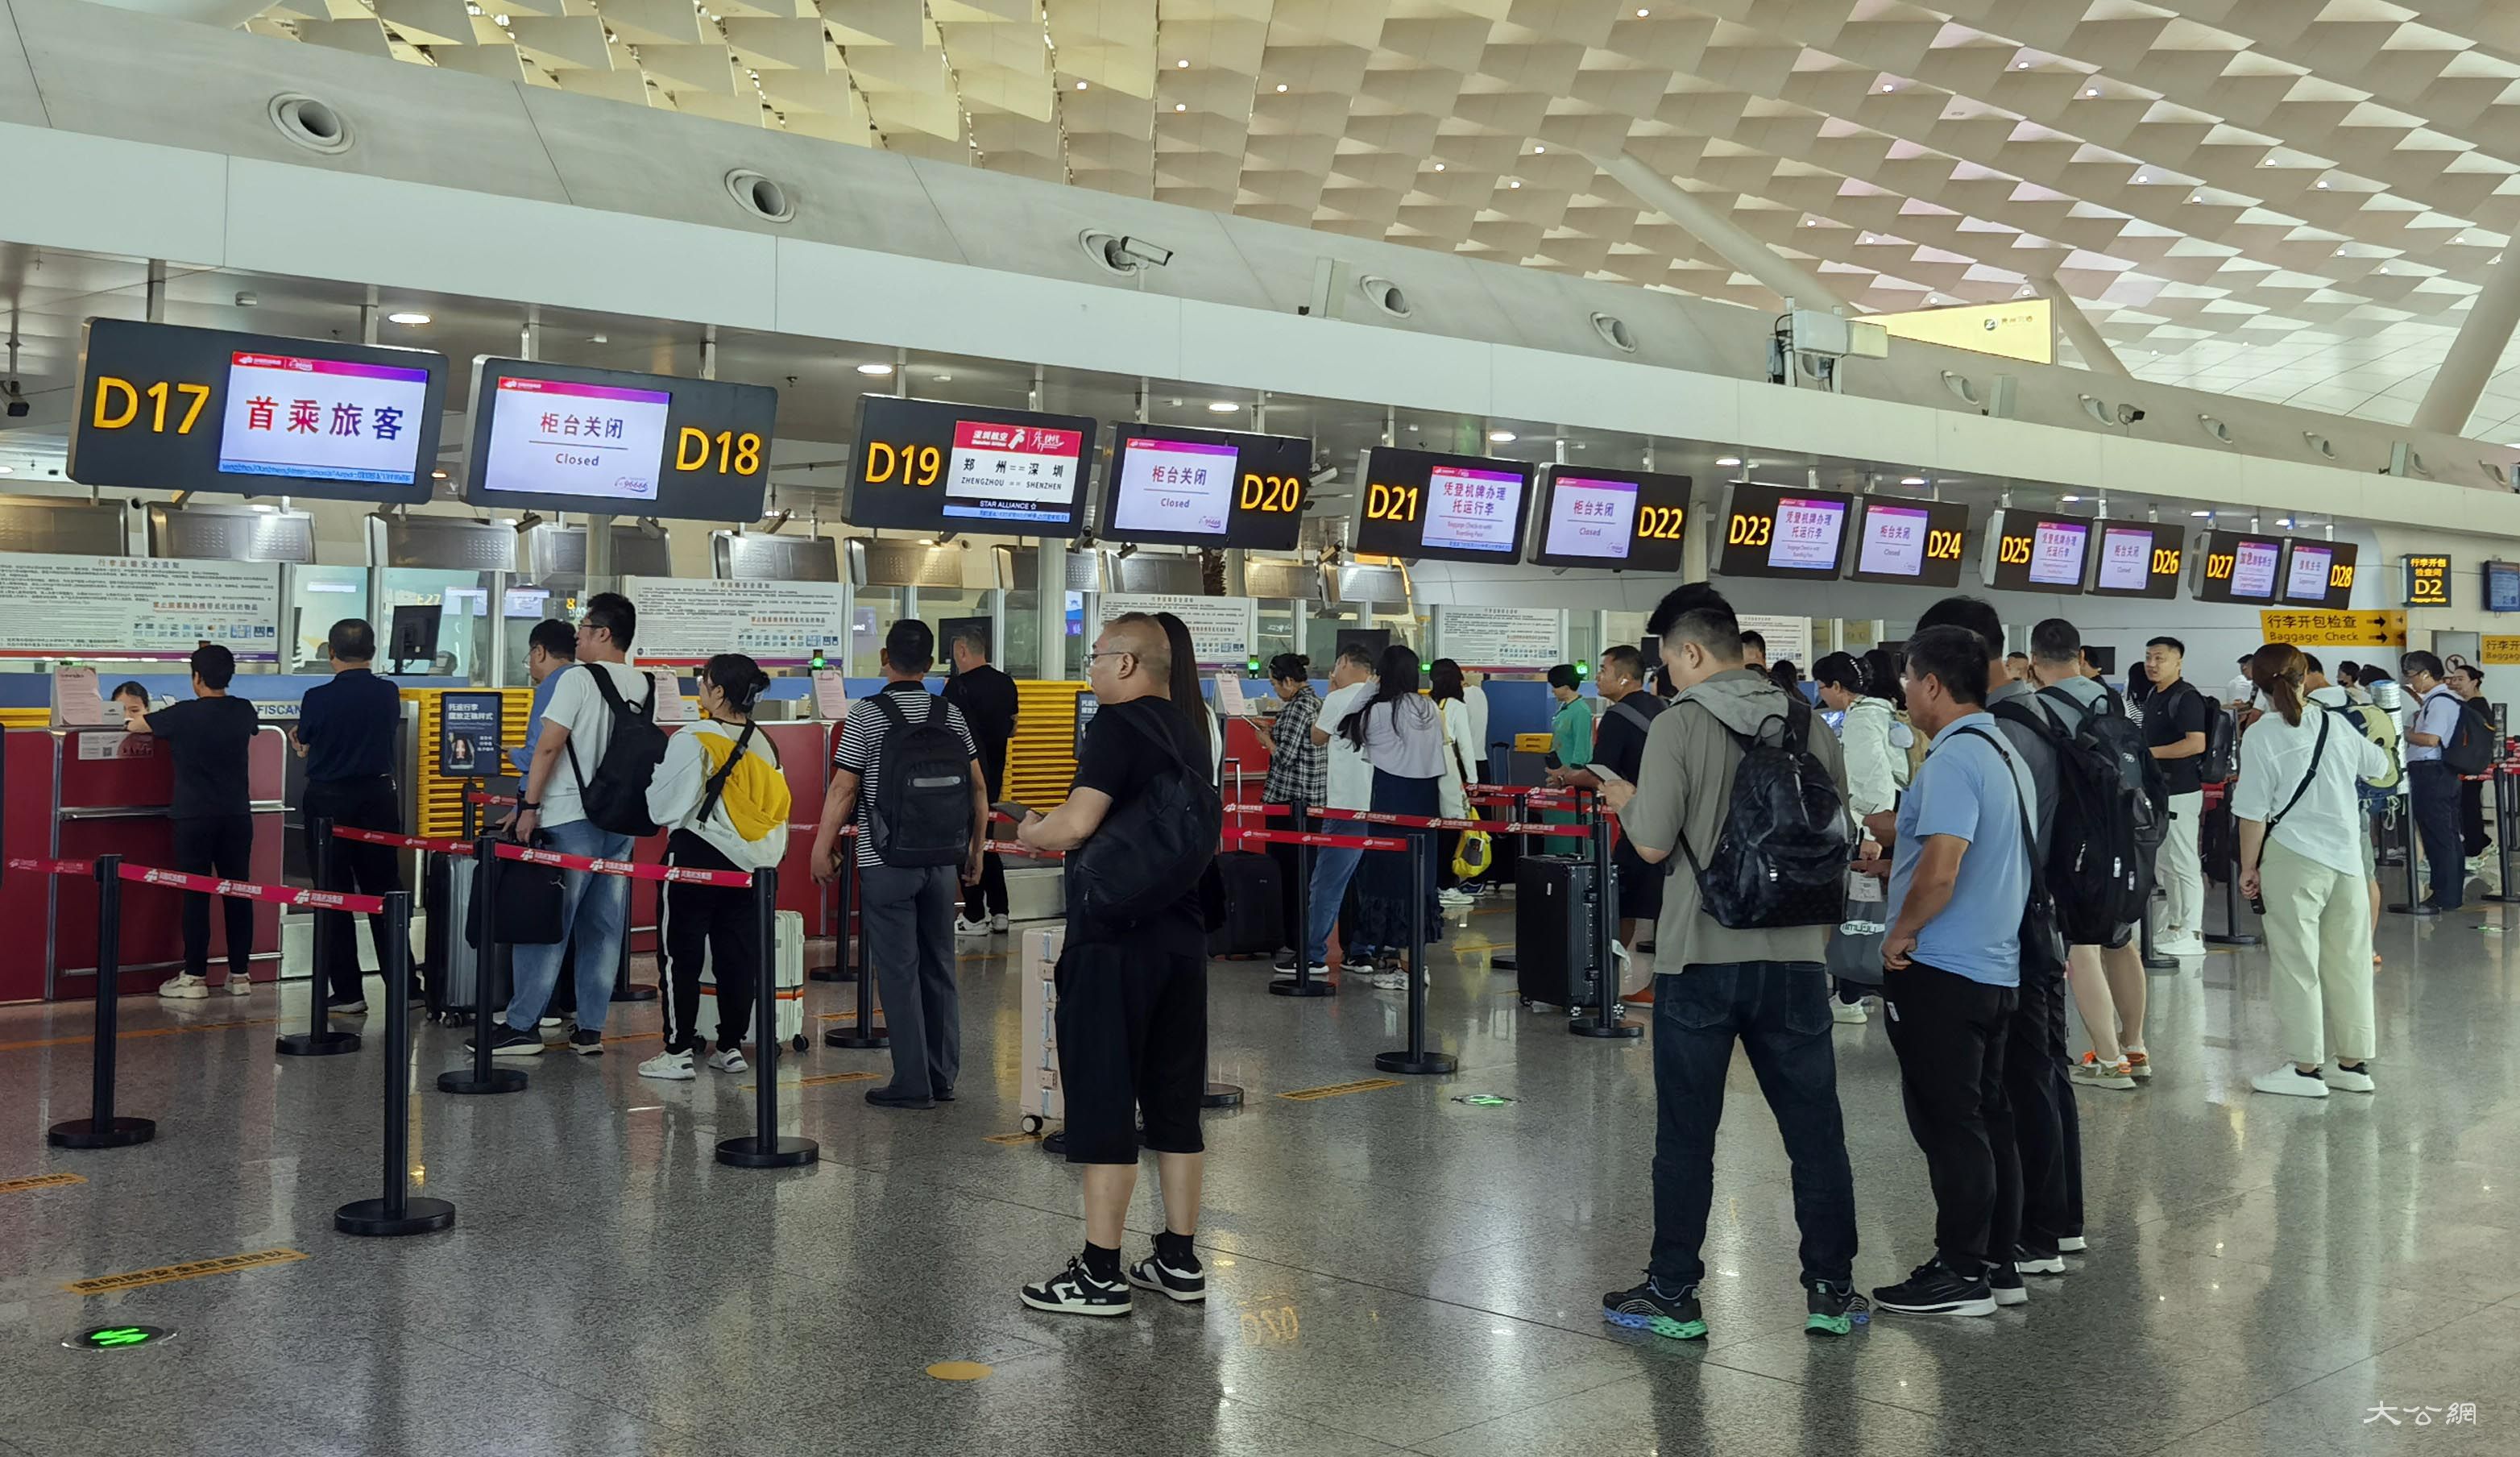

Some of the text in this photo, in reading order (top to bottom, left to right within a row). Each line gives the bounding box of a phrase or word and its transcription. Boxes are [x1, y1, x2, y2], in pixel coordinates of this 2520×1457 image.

[94, 376, 209, 434] D17
[246, 396, 404, 441] 首乘旅客
[541, 412, 624, 439] 柜台关闭
[555, 453, 599, 467] Closed
[676, 427, 761, 475] D18
[866, 442, 940, 486] D19
[963, 458, 1063, 478] 郑州 深圳
[961, 477, 1062, 490] ZHENGZHOU SHENZHEN
[1152, 465, 1207, 486] 柜台关闭
[1241, 474, 1299, 513] D20
[1444, 482, 1507, 500] 凭登机牌办理
[980, 500, 1030, 509] STAR ALLIANCE
[1160, 498, 1190, 508] Closed
[1367, 484, 1418, 521] D21
[1452, 499, 1494, 516] 托运行李
[1573, 500, 1615, 517] 柜台关闭
[1579, 527, 1601, 537] Closed
[1638, 506, 1683, 539] D22
[1730, 514, 1772, 546] D23
[1927, 530, 1962, 559] D24
[2000, 536, 2032, 563] D25
[2152, 549, 2180, 575] D26
[2207, 554, 2234, 579] D27
[2330, 565, 2353, 587] D28
[2414, 579, 2443, 595] D2
[2267, 615, 2357, 629] 行李开包检查
[2269, 631, 2359, 643] Baggage Check
